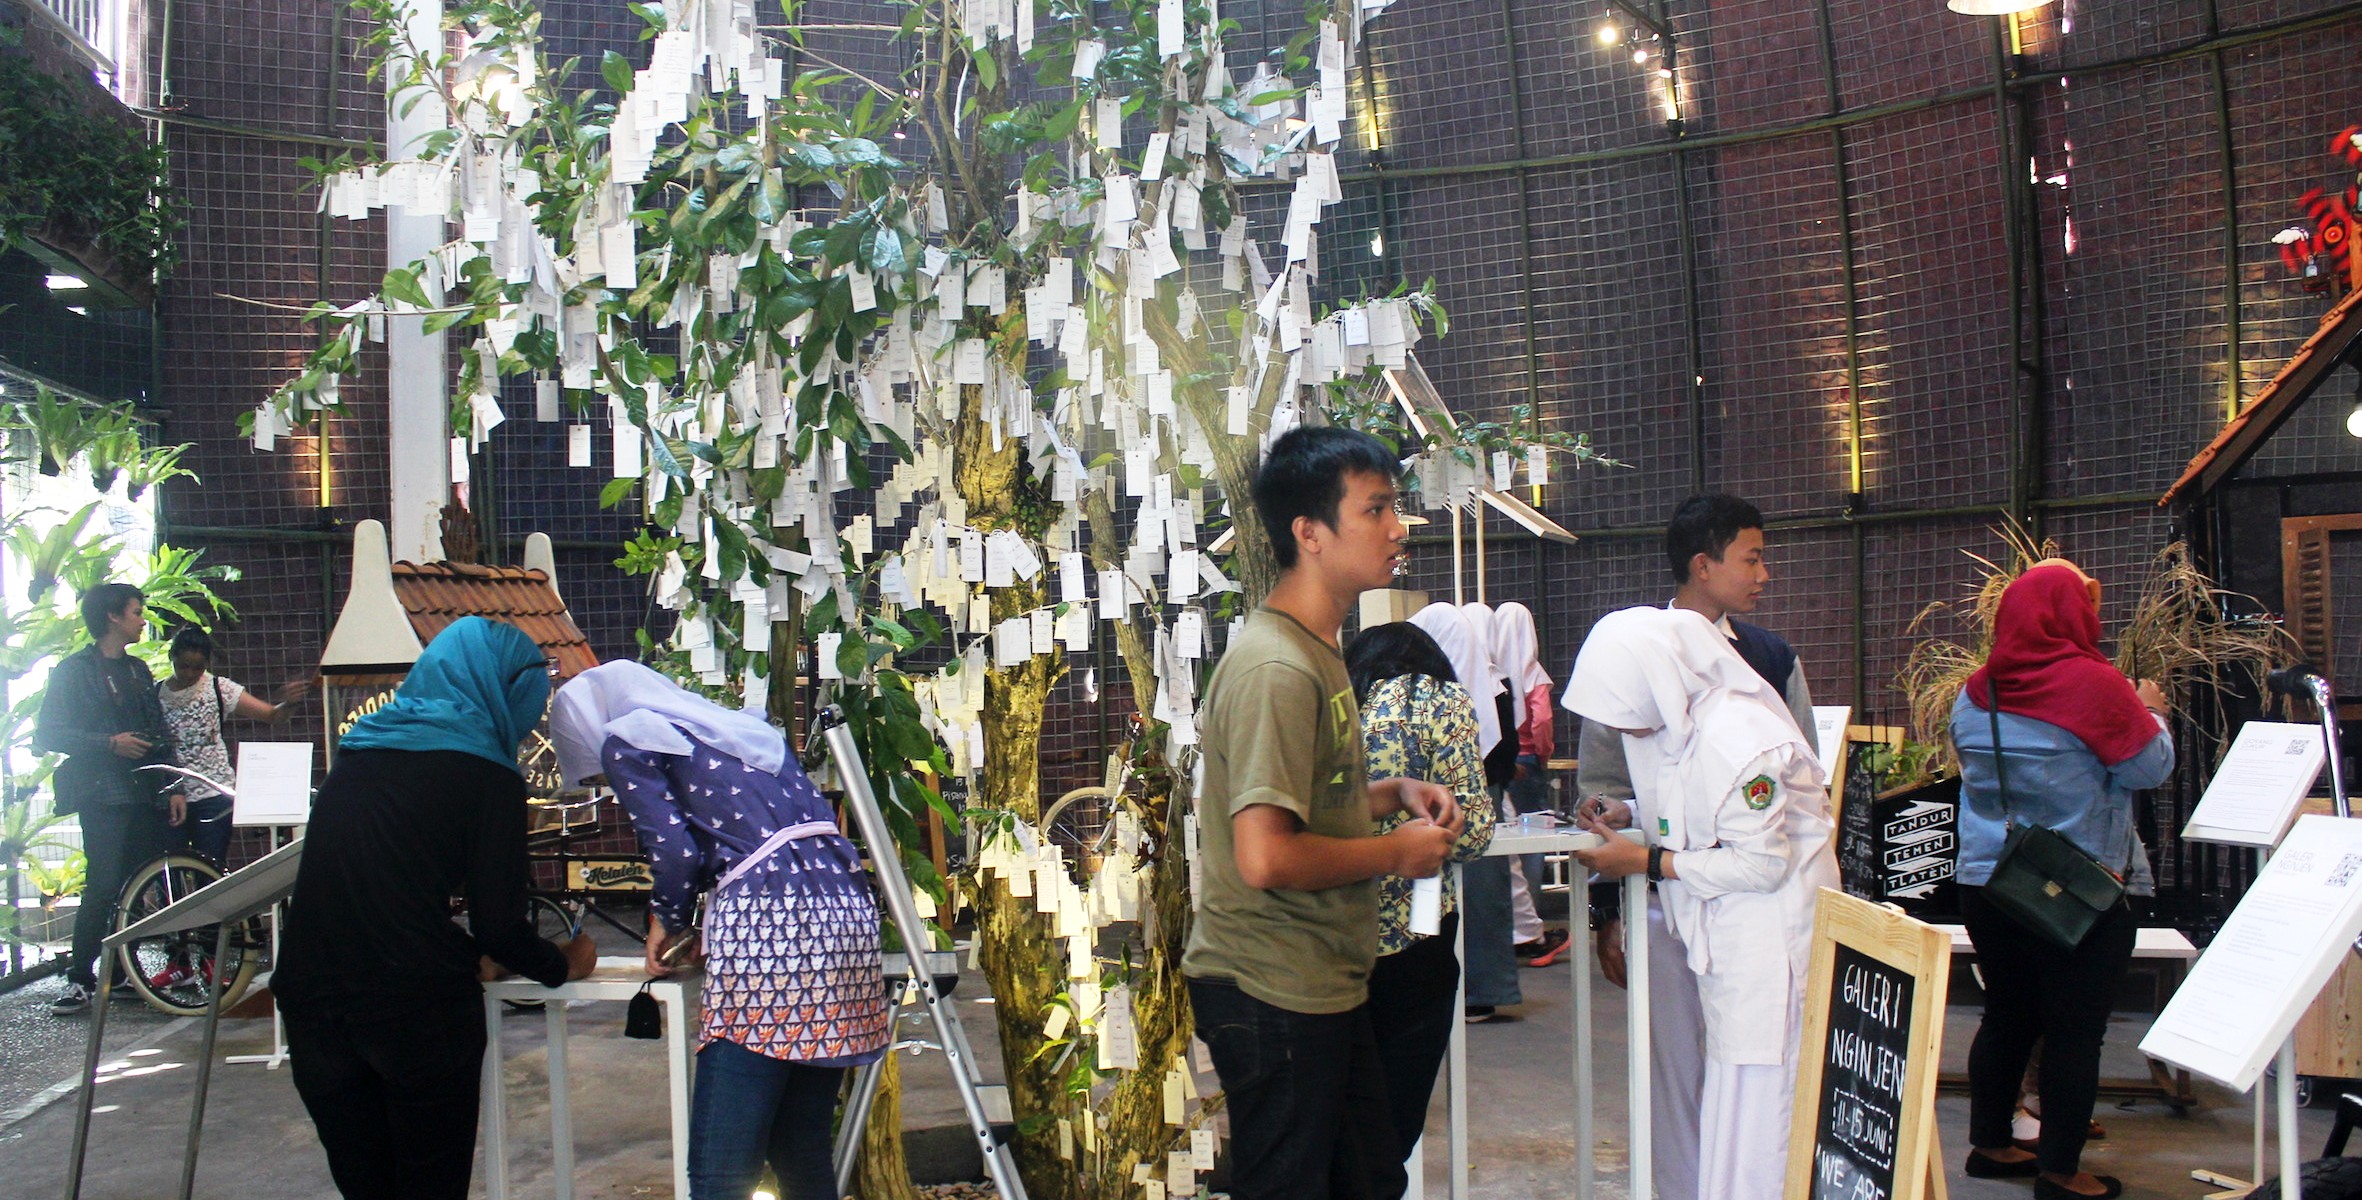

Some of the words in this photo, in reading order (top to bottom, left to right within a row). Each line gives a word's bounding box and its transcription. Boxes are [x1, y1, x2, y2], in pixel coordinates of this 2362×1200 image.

[1889, 811, 1949, 834] TANDUR
[1893, 838, 1942, 864] TEMEN
[1843, 964, 1902, 1028] GALERI
[1863, 1119, 1887, 1154] JUNI
